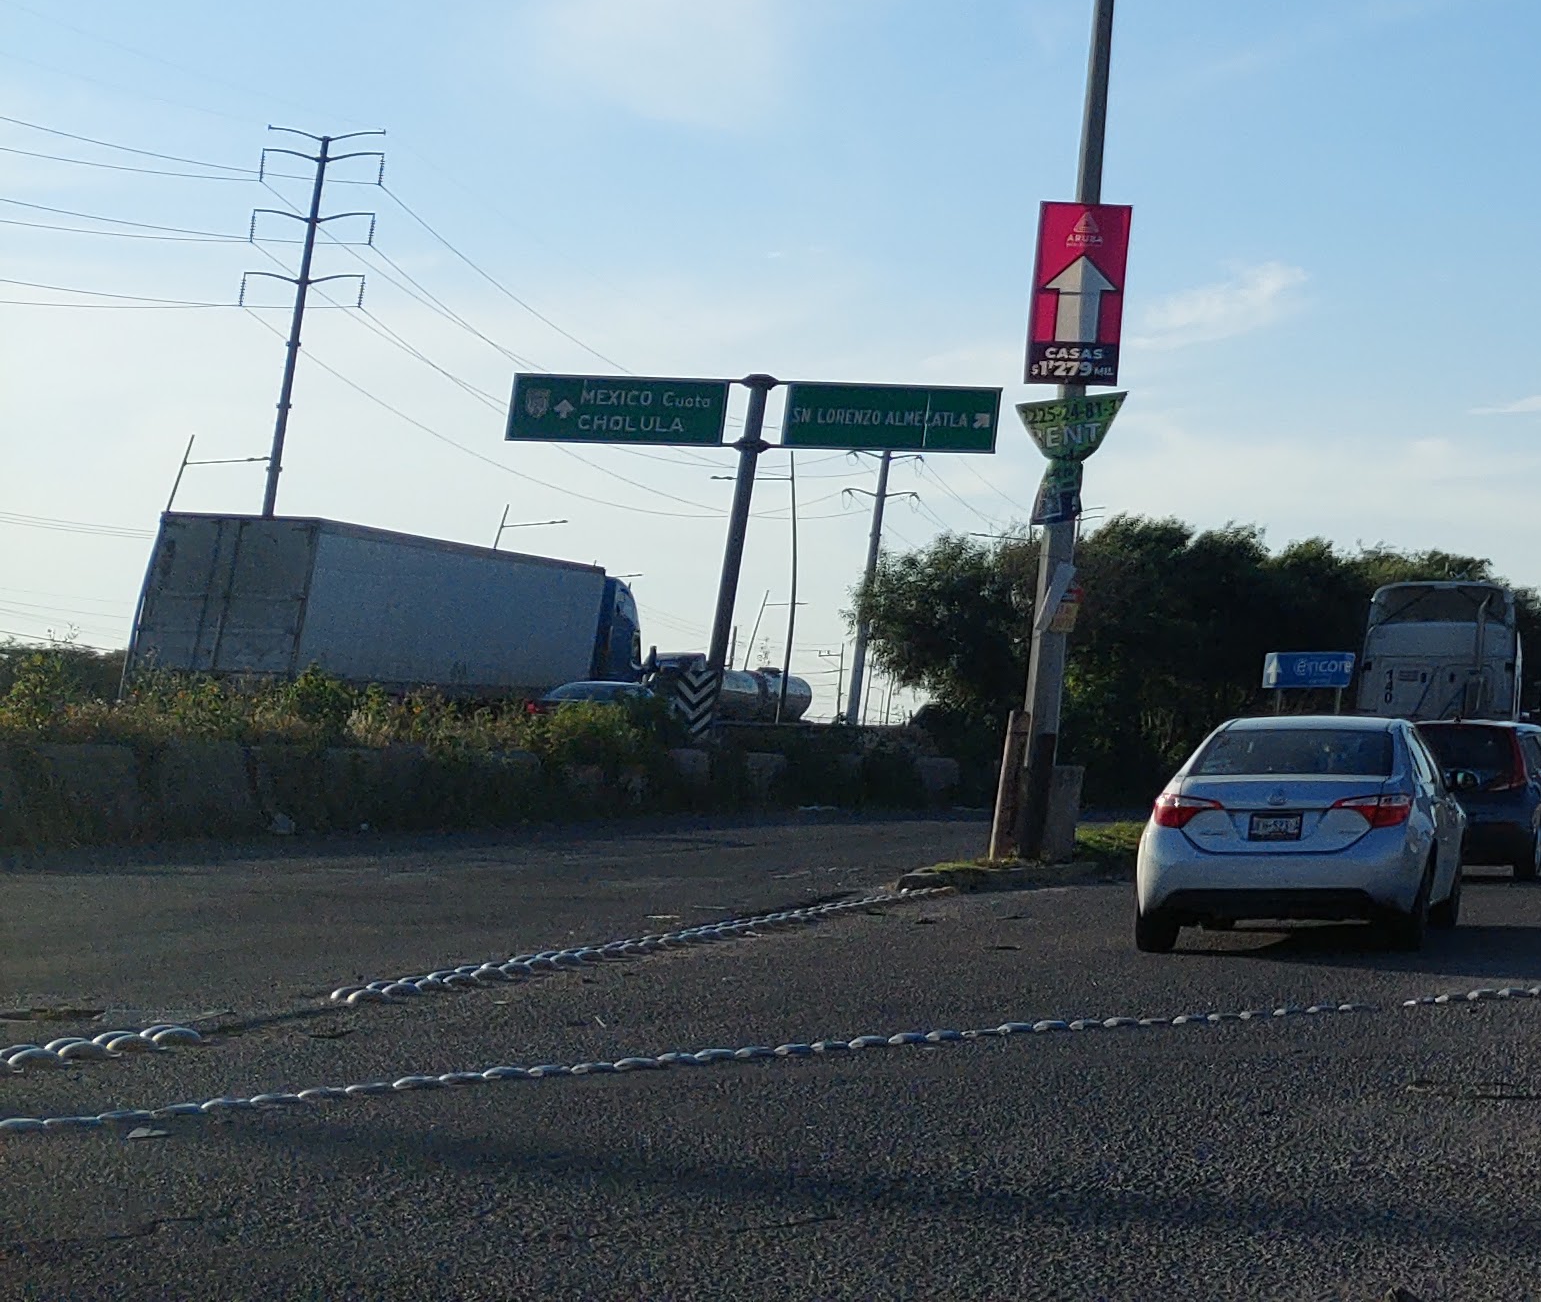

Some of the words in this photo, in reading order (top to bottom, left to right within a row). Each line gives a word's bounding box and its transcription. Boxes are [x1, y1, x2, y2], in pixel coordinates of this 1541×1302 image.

[1044, 346, 1103, 360] CASAS
[580, 388, 652, 406] MEXICO
[662, 391, 711, 408] Cuota
[577, 414, 685, 433] CHOLULA
[792, 408, 812, 424] SN
[817, 408, 881, 426] LORENZO
